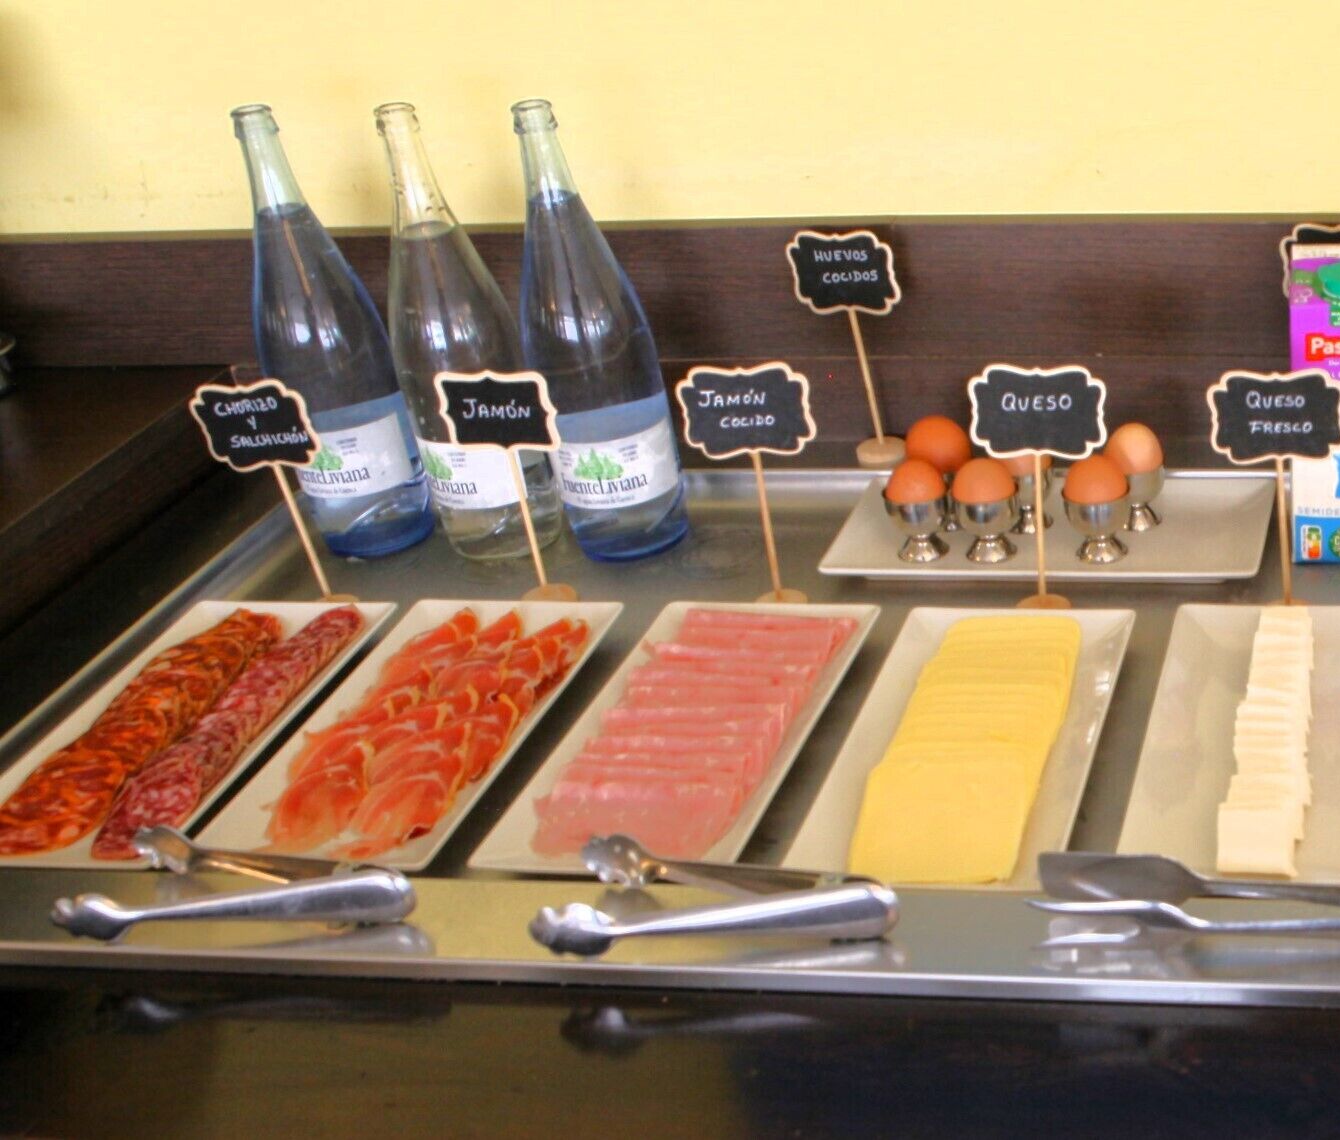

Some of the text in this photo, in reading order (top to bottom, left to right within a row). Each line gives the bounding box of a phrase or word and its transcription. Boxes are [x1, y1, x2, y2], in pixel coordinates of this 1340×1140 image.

[814, 249, 868, 262] HUEVOS
[822, 269, 879, 284] COCIDOS
[213, 396, 278, 417] CHORIZO
[698, 388, 767, 408] JAMÓN
[1001, 391, 1073, 412] QUESO
[1246, 390, 1306, 409] QUESO
[462, 399, 531, 419] JAMÓN
[247, 414, 258, 430] Y
[720, 415, 776, 428] COCIDO
[1249, 420, 1313, 434] FRESCO
[229, 426, 309, 448] SALCHICHÓN
